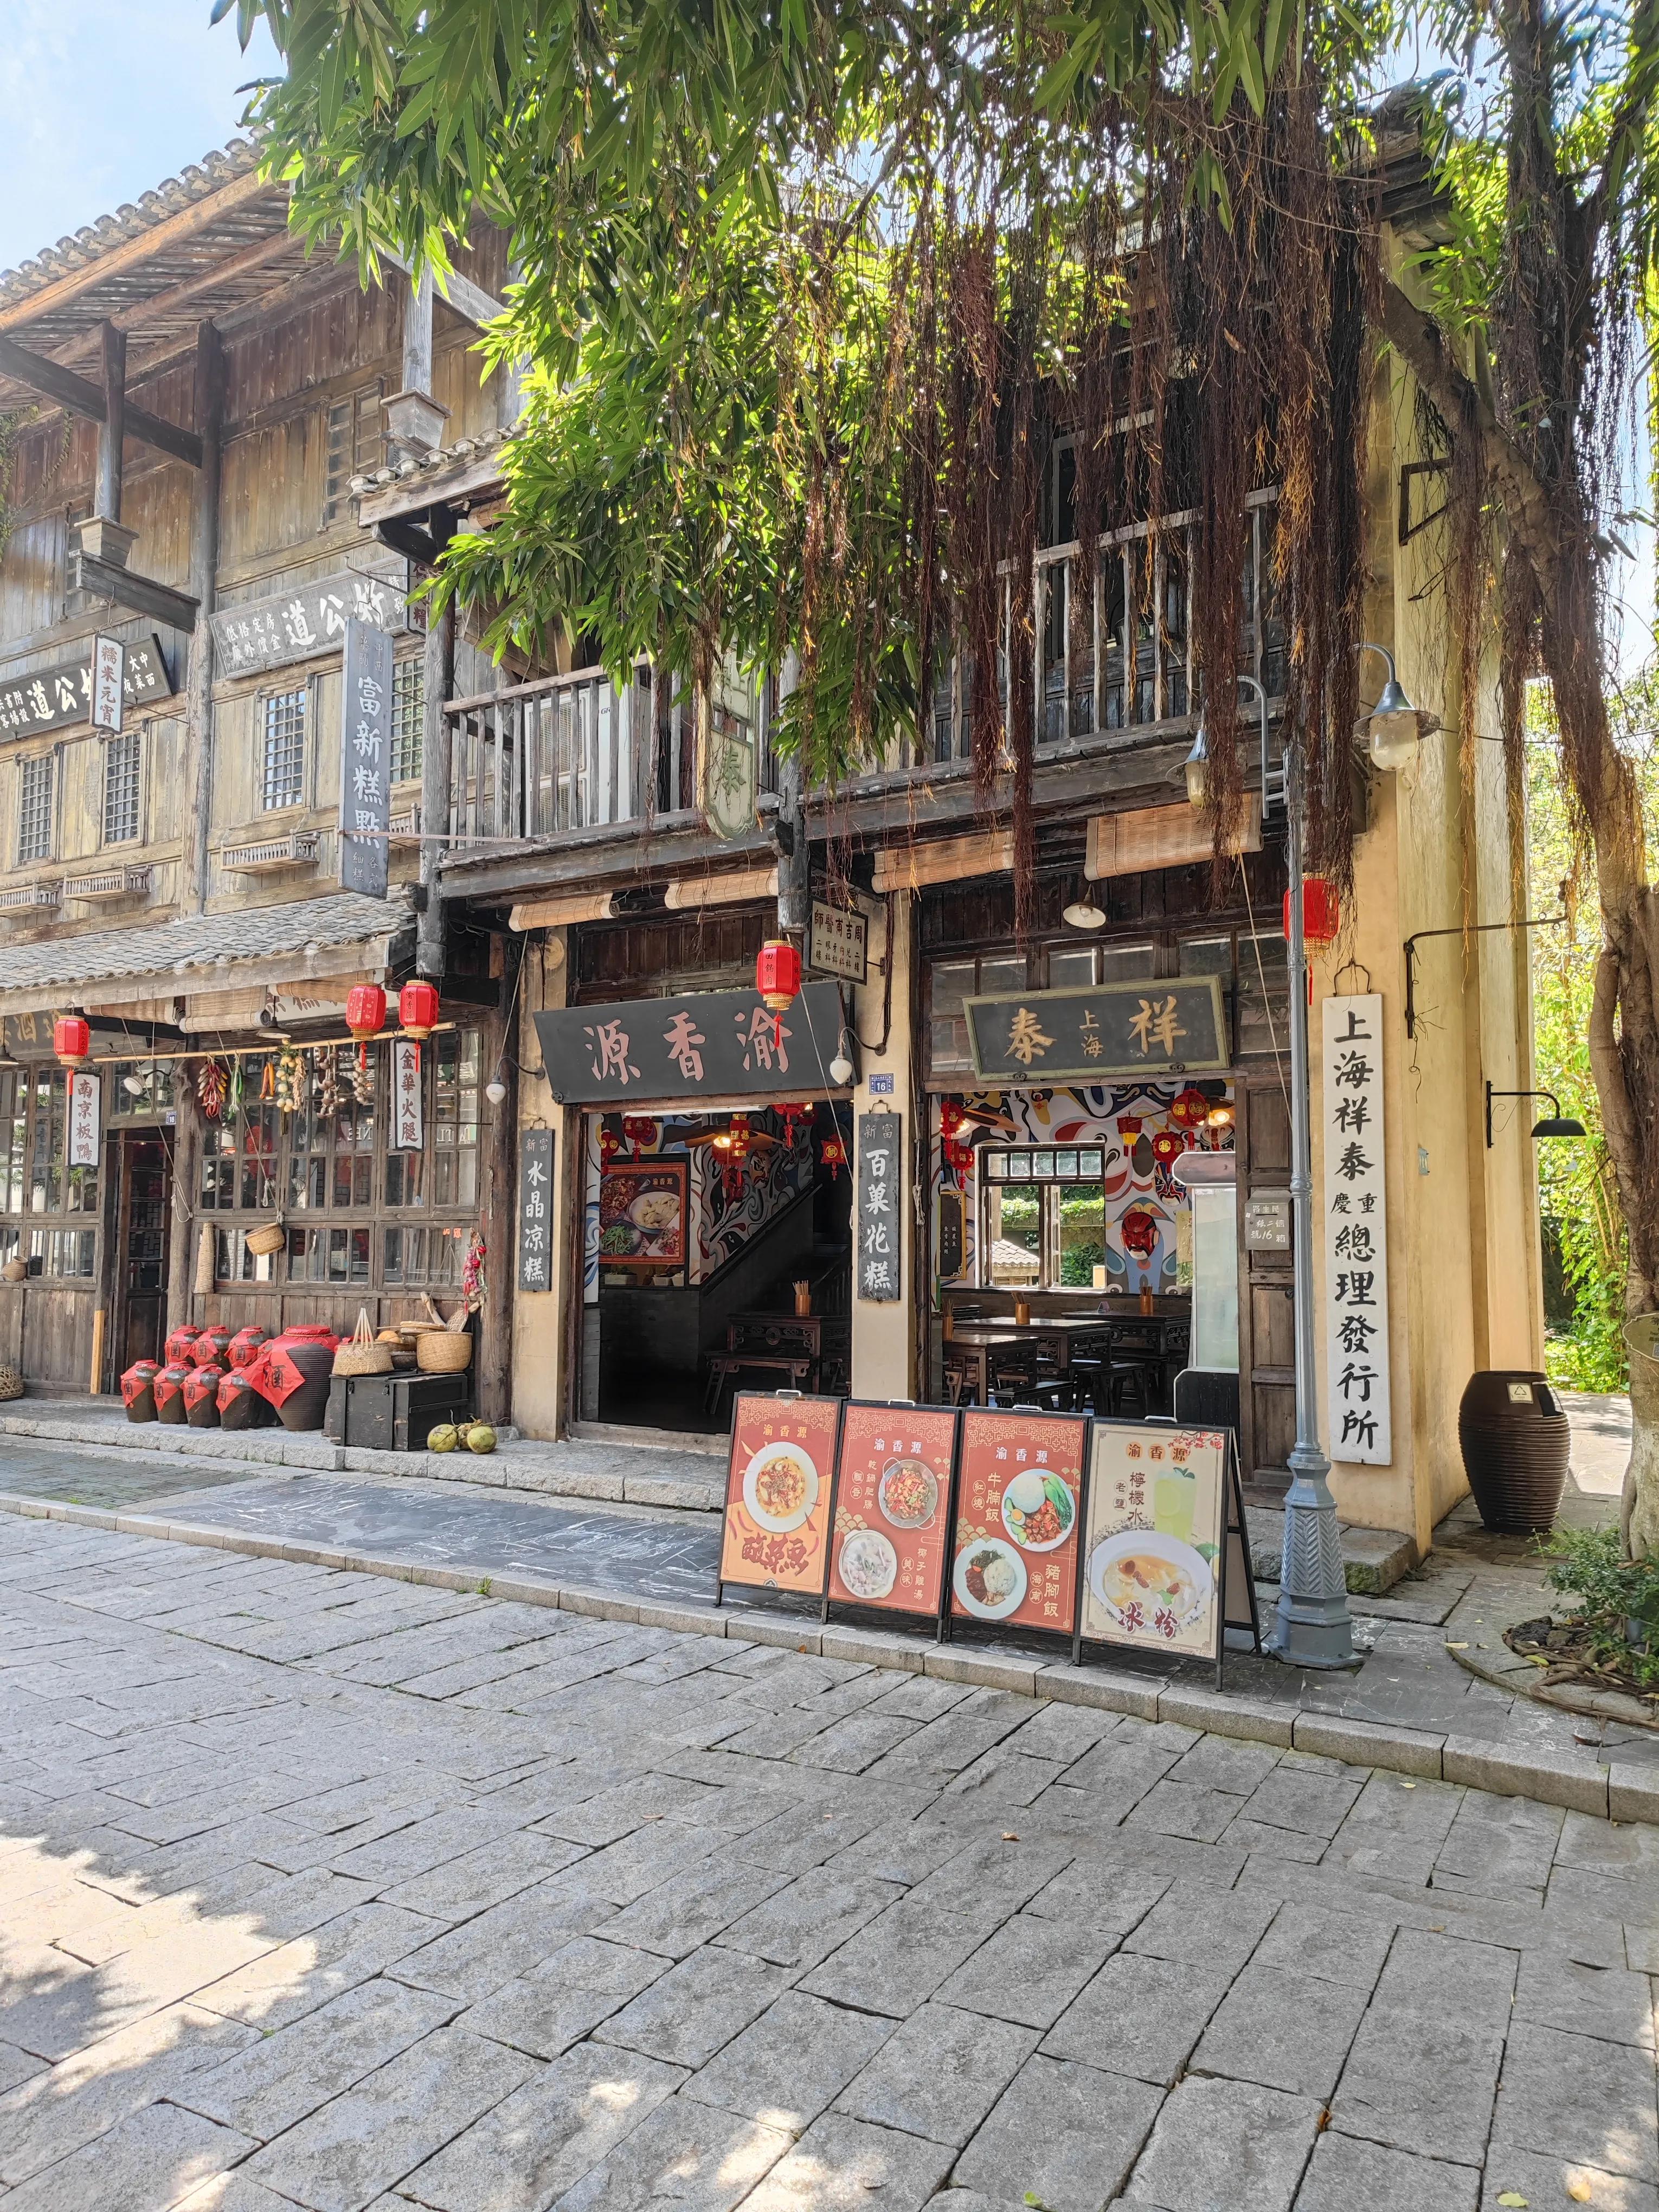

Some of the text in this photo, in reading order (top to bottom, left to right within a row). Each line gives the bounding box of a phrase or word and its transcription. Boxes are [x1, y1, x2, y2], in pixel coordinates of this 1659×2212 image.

[100, 645, 117, 724] 糯米元宵
[353, 676, 383, 849] 富新糕點
[369, 856, 378, 888] 各式
[582, 1007, 793, 1085] 渝香源
[1079, 1009, 1104, 1057] 上海
[400, 1049, 419, 1142] 金華火腿
[877, 1082, 886, 1091] 16
[75, 1078, 94, 1161] 南京板鴨
[864, 1123, 893, 1140] 富新
[525, 1137, 548, 1152] 富新
[864, 1149, 891, 1289] 百菓花糕
[763, 1424, 808, 1438] 渝香源
[873, 1438, 922, 1454] 渝香源
[995, 1446, 1048, 1463] 渝香源
[1128, 1444, 1186, 1462] 渝香源
[985, 1472, 1002, 1522] 牛腩飯
[1128, 1471, 1146, 1523] 檸檬水
[902, 1558, 913, 1586] 美味
[914, 1548, 928, 1600] 椰子雞湯
[1031, 1573, 1042, 1602] 海南
[1117, 1601, 1179, 1639] 冰粉
